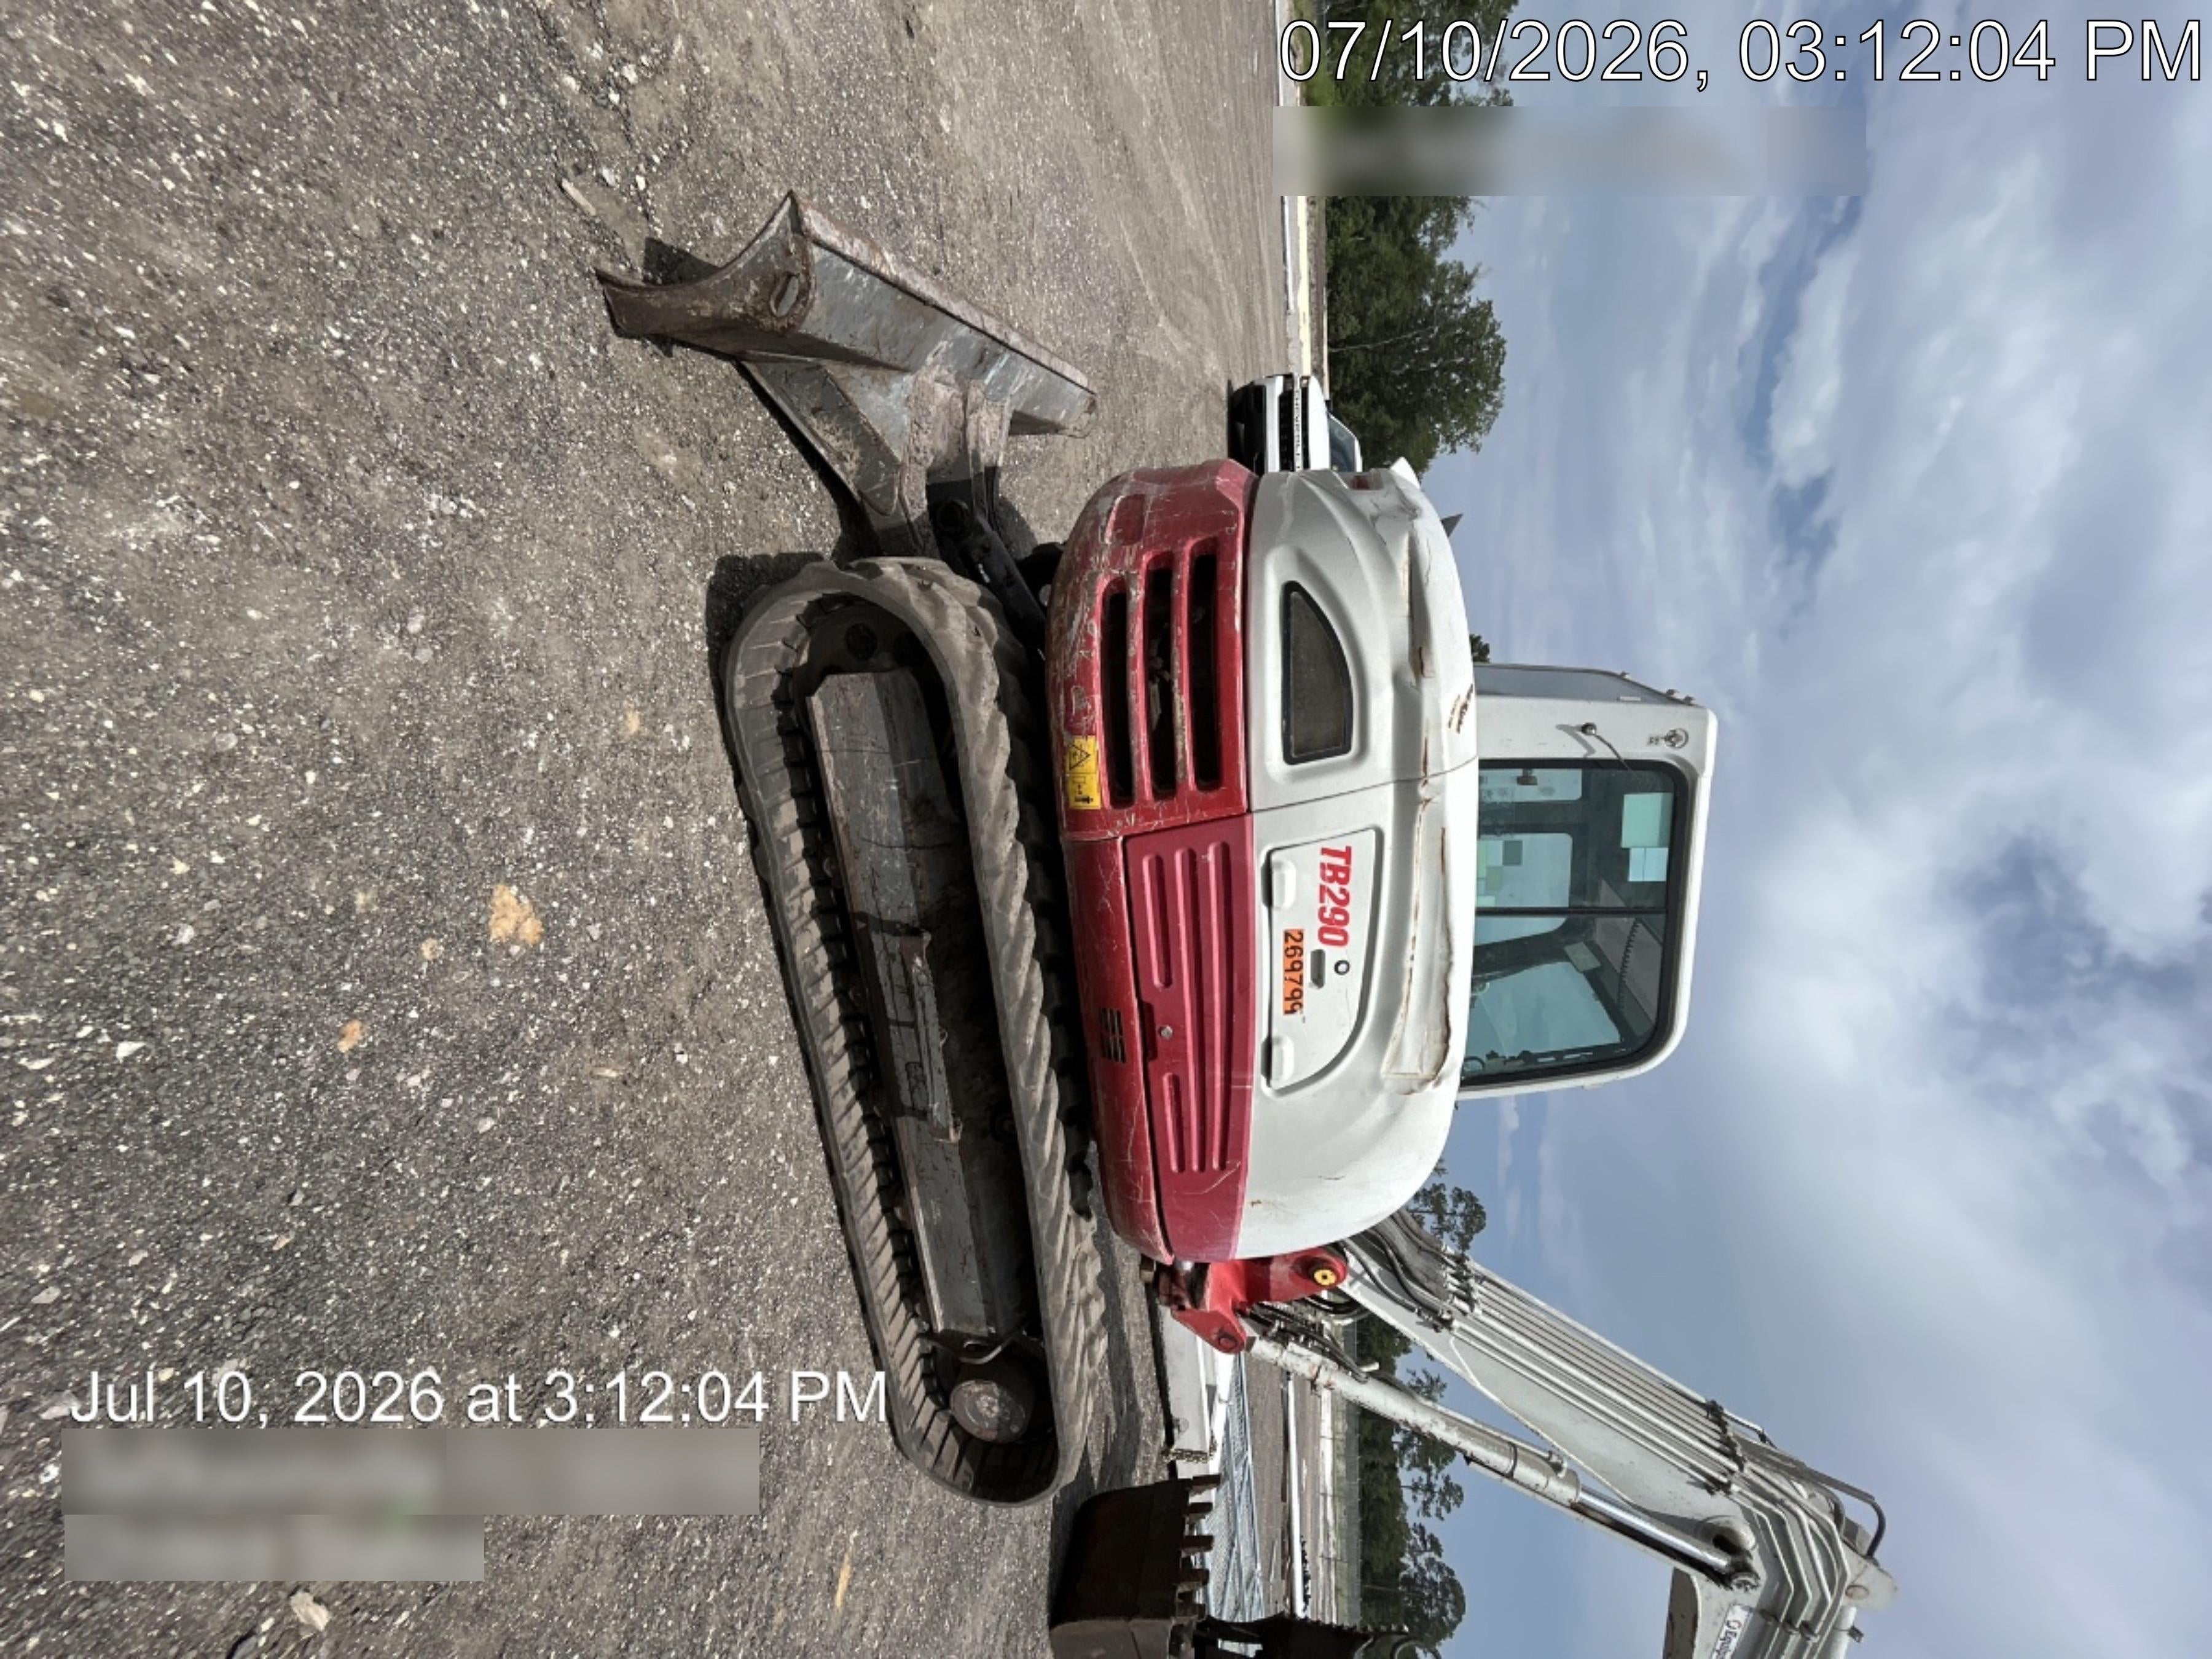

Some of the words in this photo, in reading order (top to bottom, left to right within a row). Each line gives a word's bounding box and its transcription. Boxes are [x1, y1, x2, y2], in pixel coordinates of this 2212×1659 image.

[1317, 845, 1352, 947] TB290
[1284, 931, 1304, 1015] 269799
[1716, 1631, 1737, 1659] Equip
